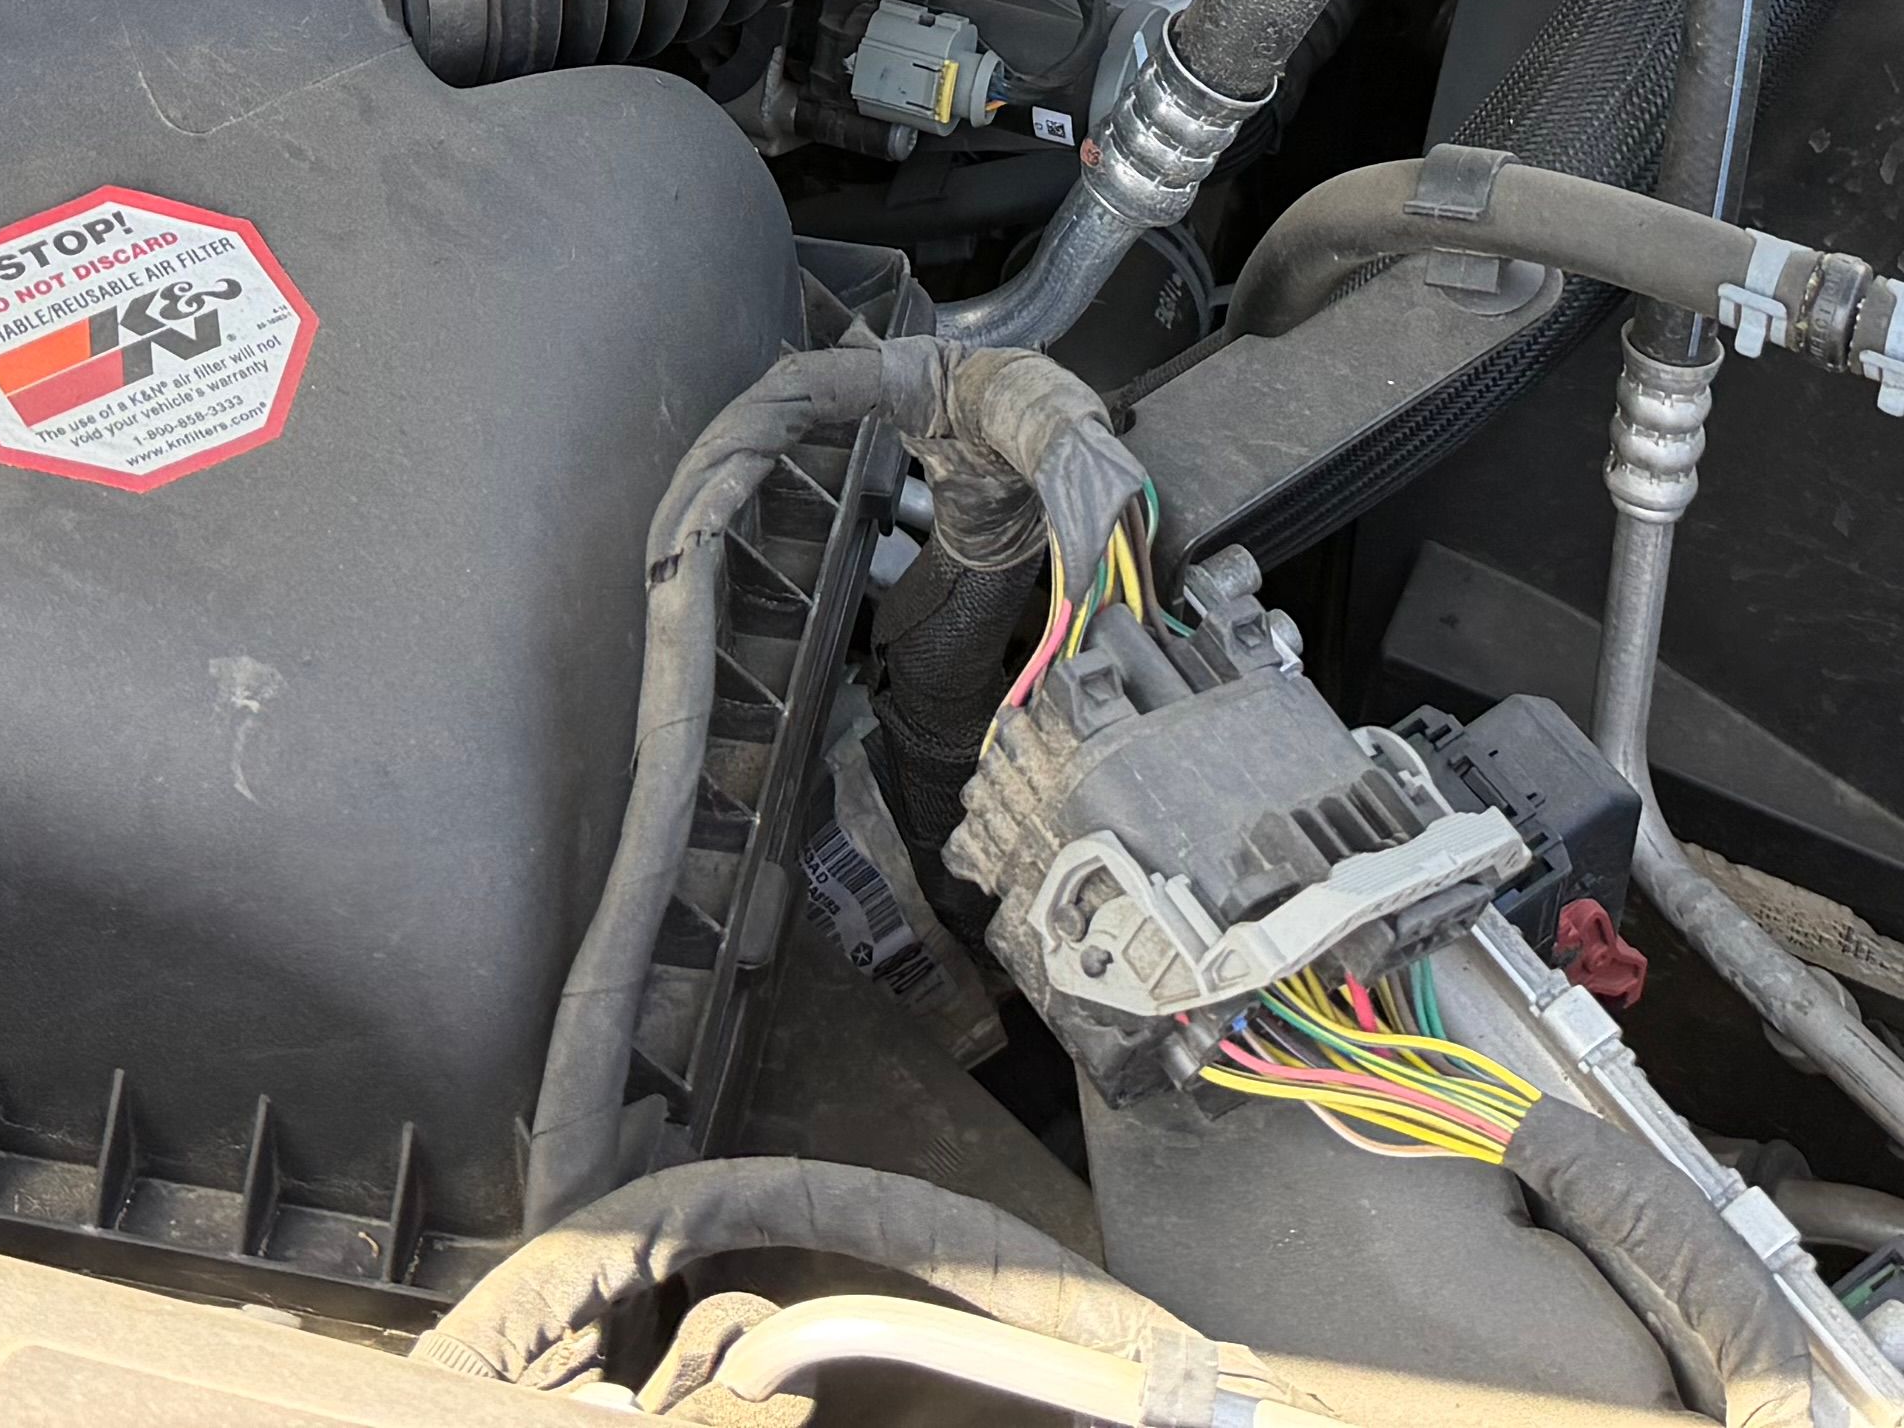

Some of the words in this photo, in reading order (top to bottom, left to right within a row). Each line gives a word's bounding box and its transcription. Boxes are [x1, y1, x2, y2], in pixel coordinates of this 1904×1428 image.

[15, 272, 66, 303] NOT
[73, 232, 179, 281] DISCARD
[146, 259, 176, 282] AIR
[176, 237, 236, 268] FILTER
[35, 426, 66, 443] The
[69, 414, 97, 432] use
[100, 403, 114, 419] of
[119, 401, 128, 412] a
[173, 372, 192, 389] air
[194, 358, 228, 379] filter
[231, 346, 256, 365] will
[258, 335, 282, 354] not
[70, 429, 102, 448] void
[104, 414, 140, 437] your
[142, 388, 206, 419] vehicle's
[206, 359, 269, 391] warranty
[132, 394, 244, 446] 1-800-858-3333
